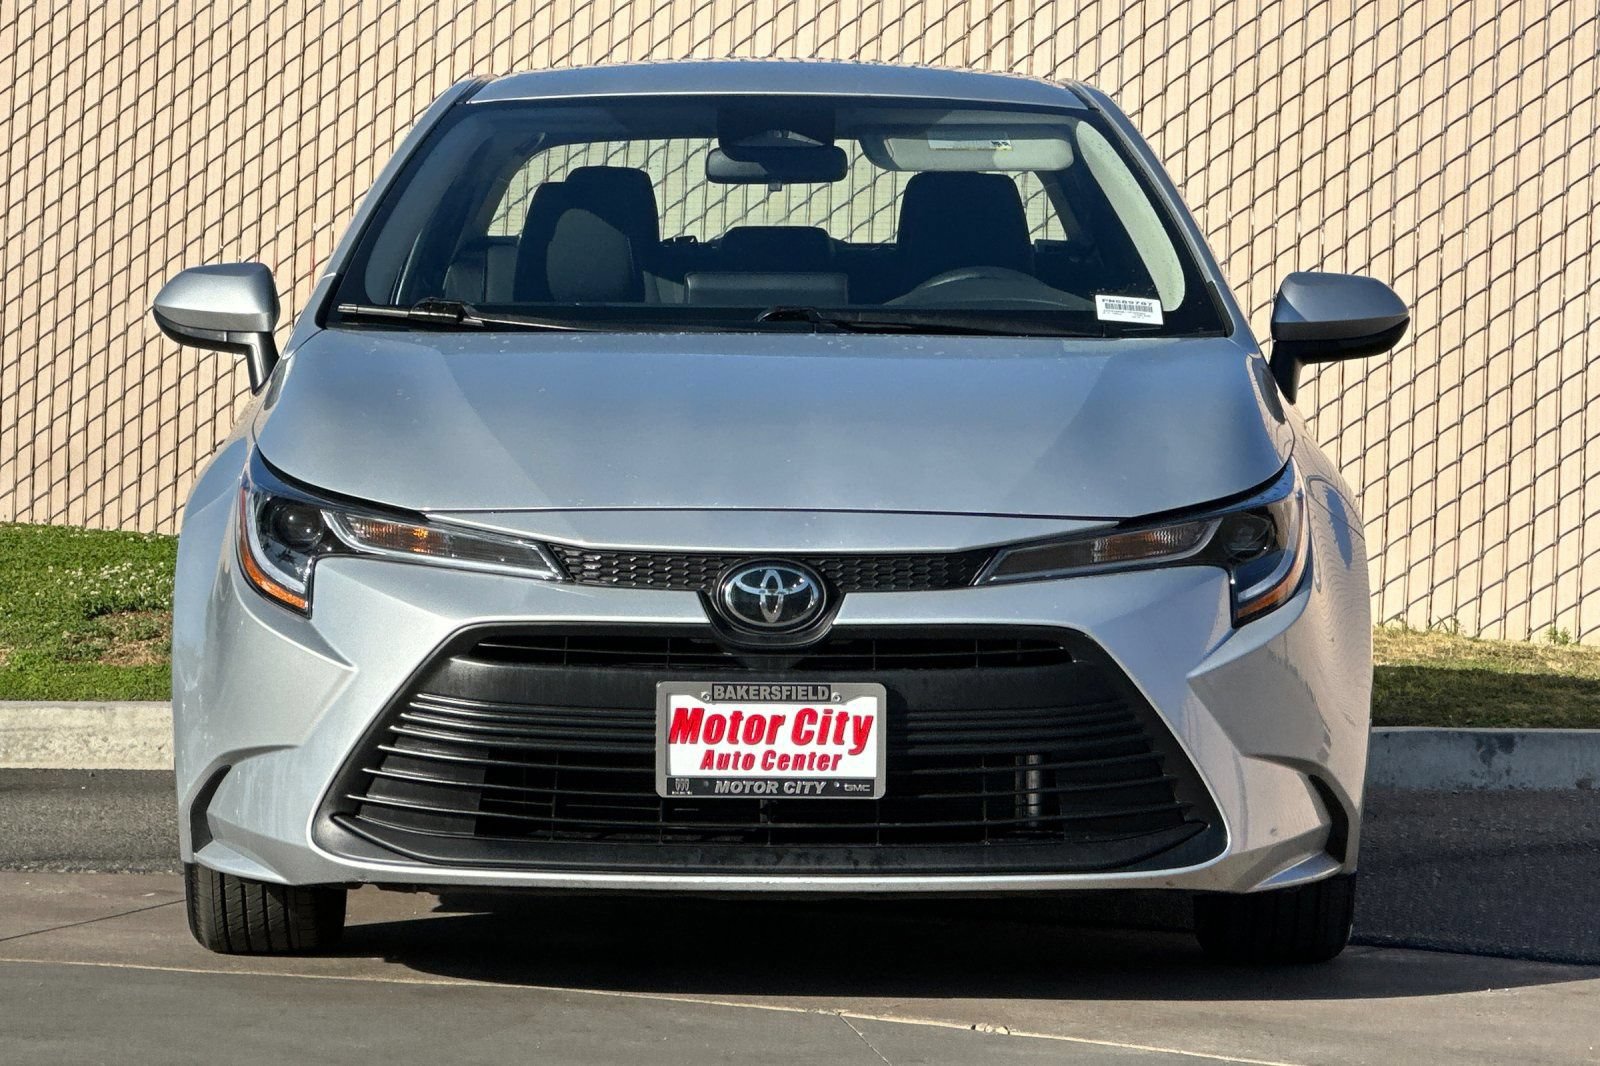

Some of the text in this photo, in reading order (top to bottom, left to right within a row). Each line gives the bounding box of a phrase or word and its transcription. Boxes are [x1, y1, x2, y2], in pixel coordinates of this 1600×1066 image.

[713, 685, 829, 702] BAKERSFIELD
[668, 707, 874, 756] Motor City
[700, 749, 843, 771] Auto Center
[714, 780, 827, 794] MOTOR CITY
[844, 782, 871, 792] GMC
